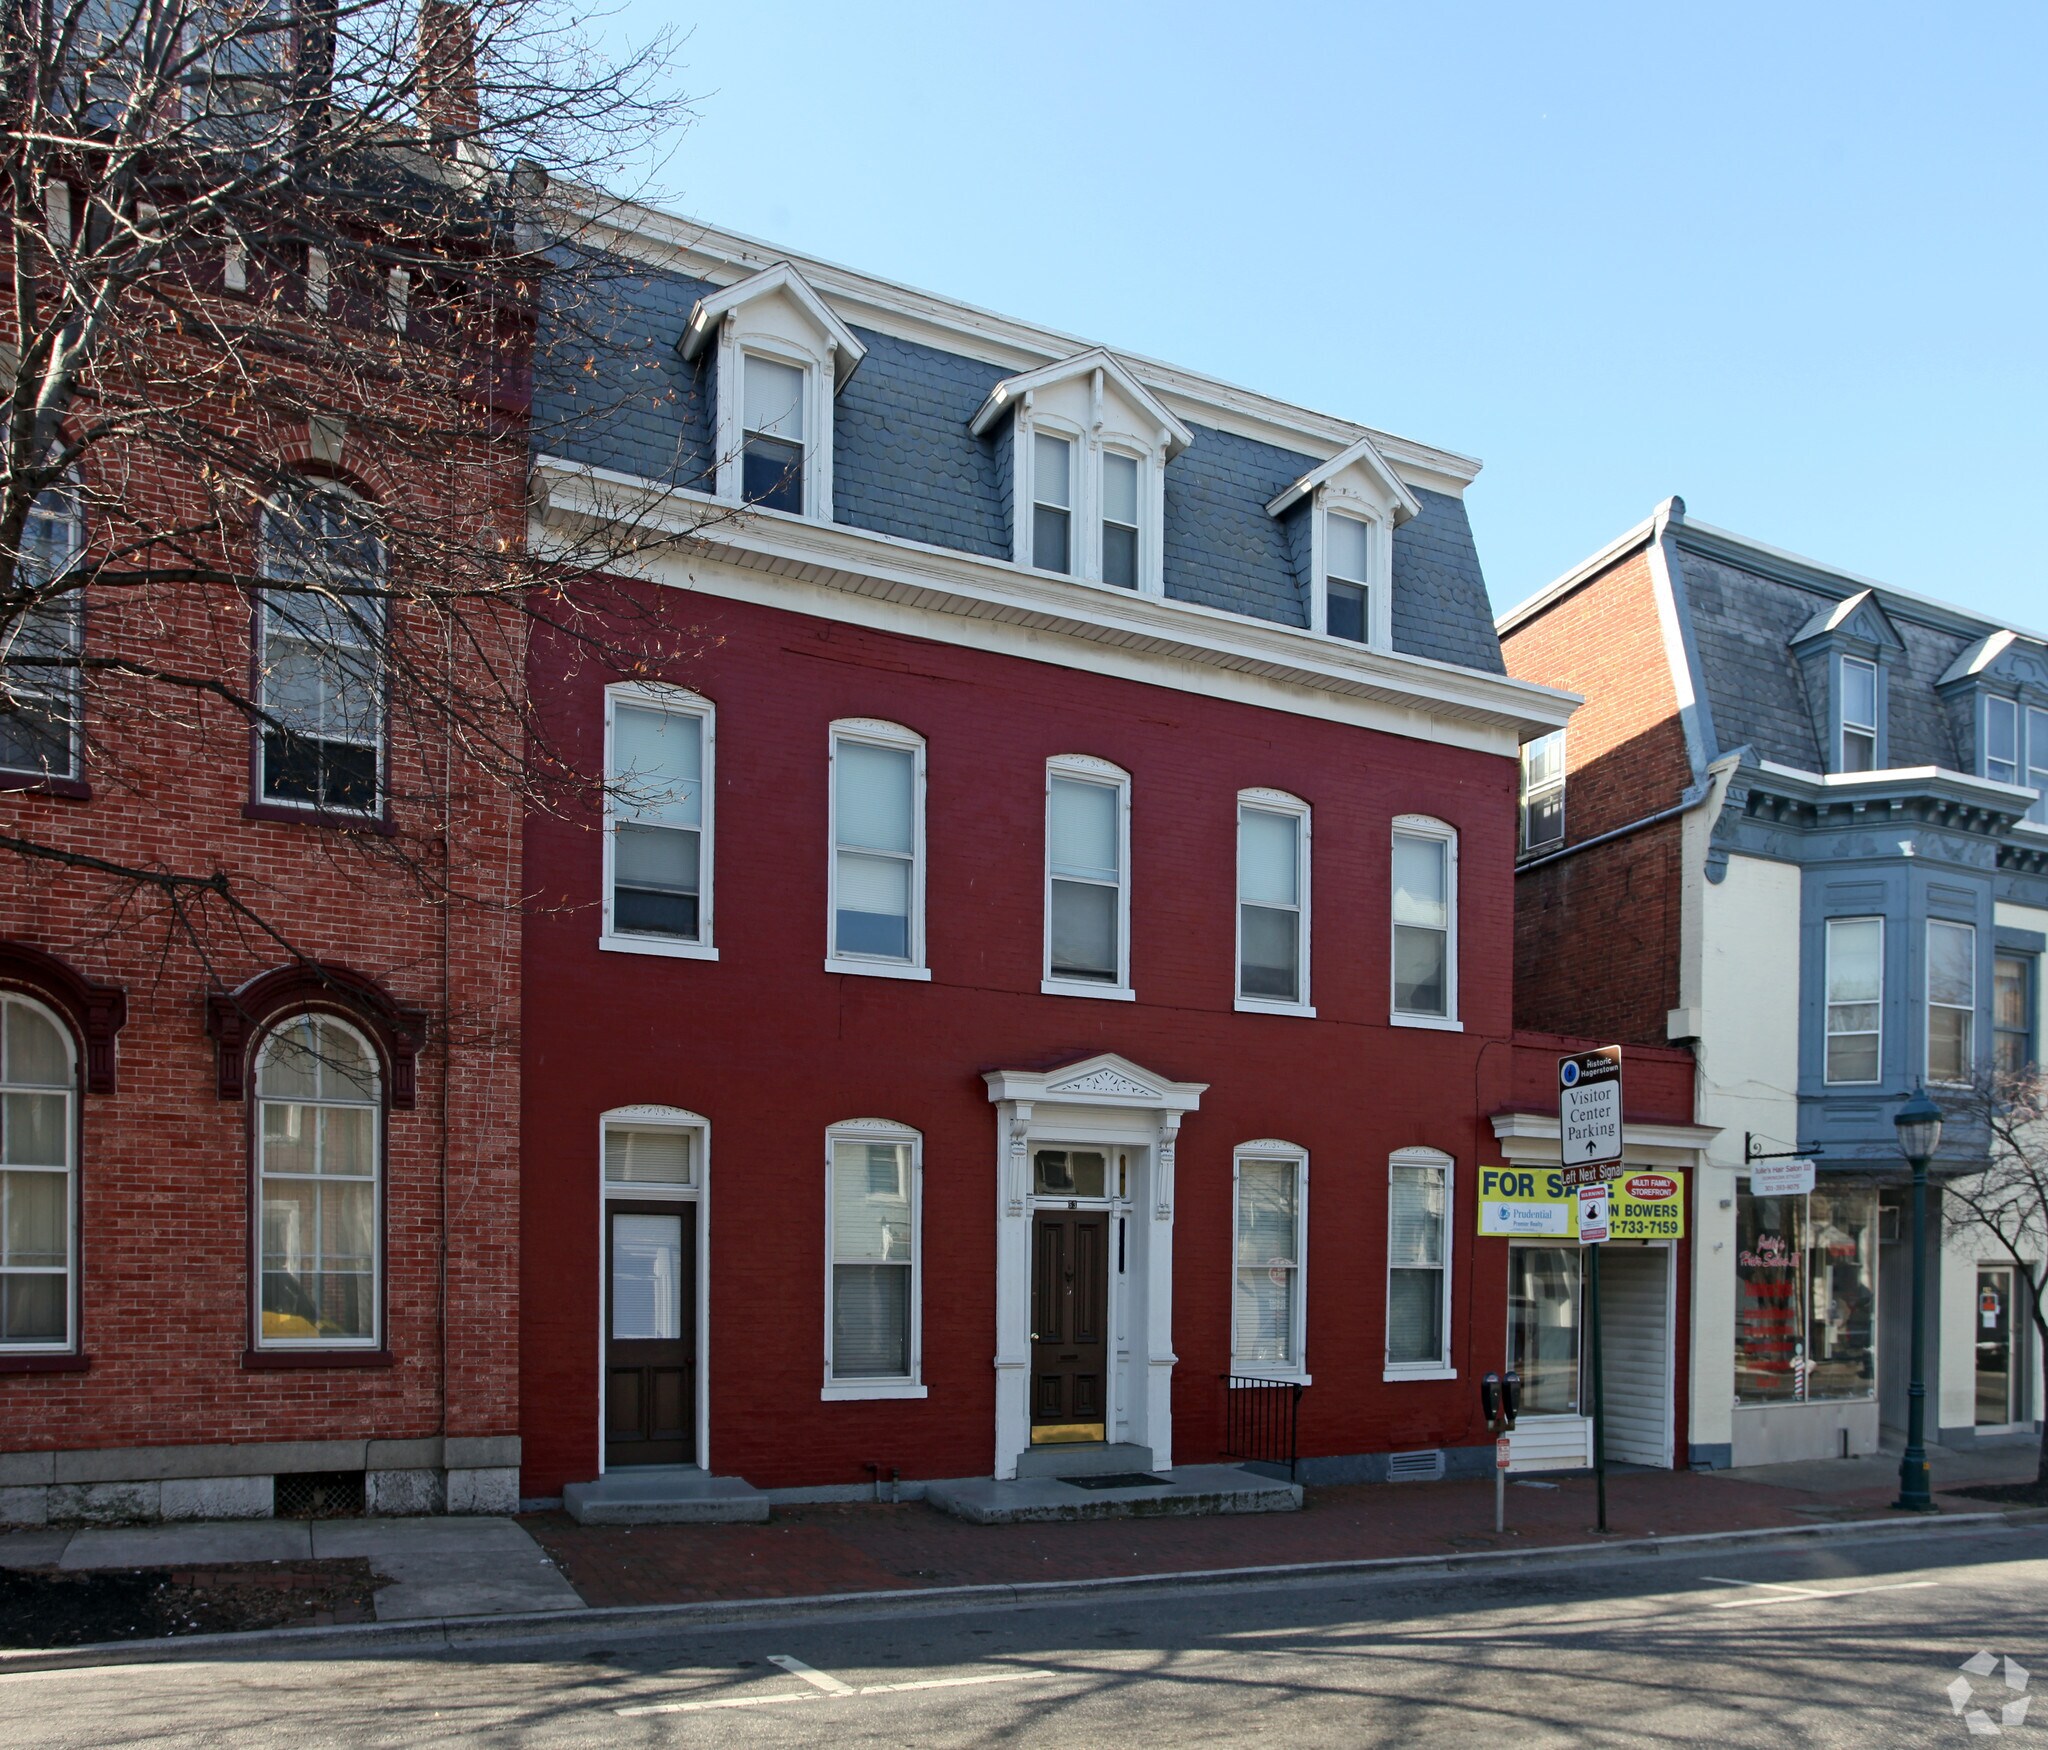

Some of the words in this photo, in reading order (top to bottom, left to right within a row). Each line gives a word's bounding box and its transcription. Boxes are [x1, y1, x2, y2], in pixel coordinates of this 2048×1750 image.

[1586, 1057, 1612, 1069] Historic
[1580, 1065, 1619, 1078] Hagerstown
[1570, 1089, 1611, 1105] Visitor
[1570, 1106, 1611, 1123] Center
[1568, 1123, 1615, 1141] Parking
[1561, 1170, 1577, 1185] Left
[1579, 1166, 1597, 1181] Next
[1599, 1162, 1623, 1179] Signal
[1483, 1171, 1535, 1197] FOR
[1546, 1173, 1615, 1198] SA
[1631, 1188, 1672, 1196] STOREFRONT
[1513, 1209, 1552, 1219] Prudential
[1625, 1204, 1678, 1218] BOWERS
